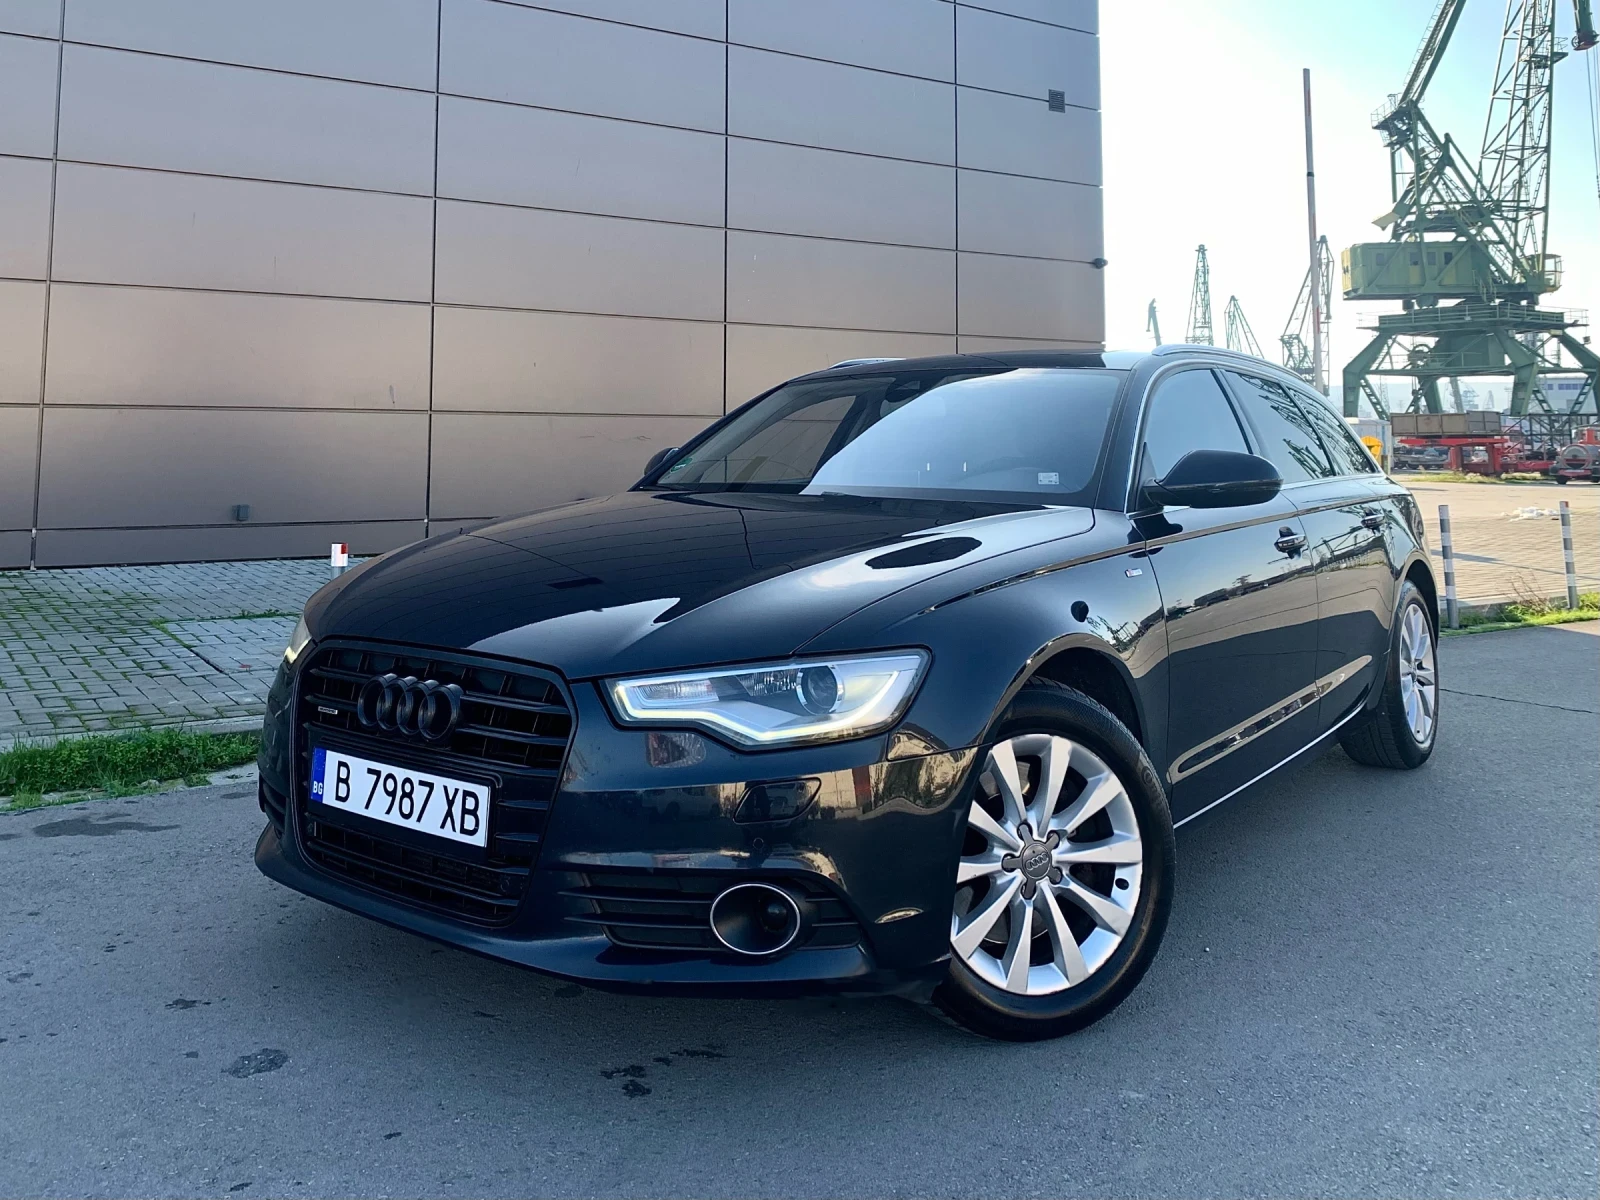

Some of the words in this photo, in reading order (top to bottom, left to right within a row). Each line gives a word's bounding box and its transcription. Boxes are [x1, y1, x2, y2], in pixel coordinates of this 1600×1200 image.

[312, 781, 323, 795] BG
[335, 761, 351, 803] B
[364, 768, 435, 823] 7987
[440, 785, 481, 837] XB
